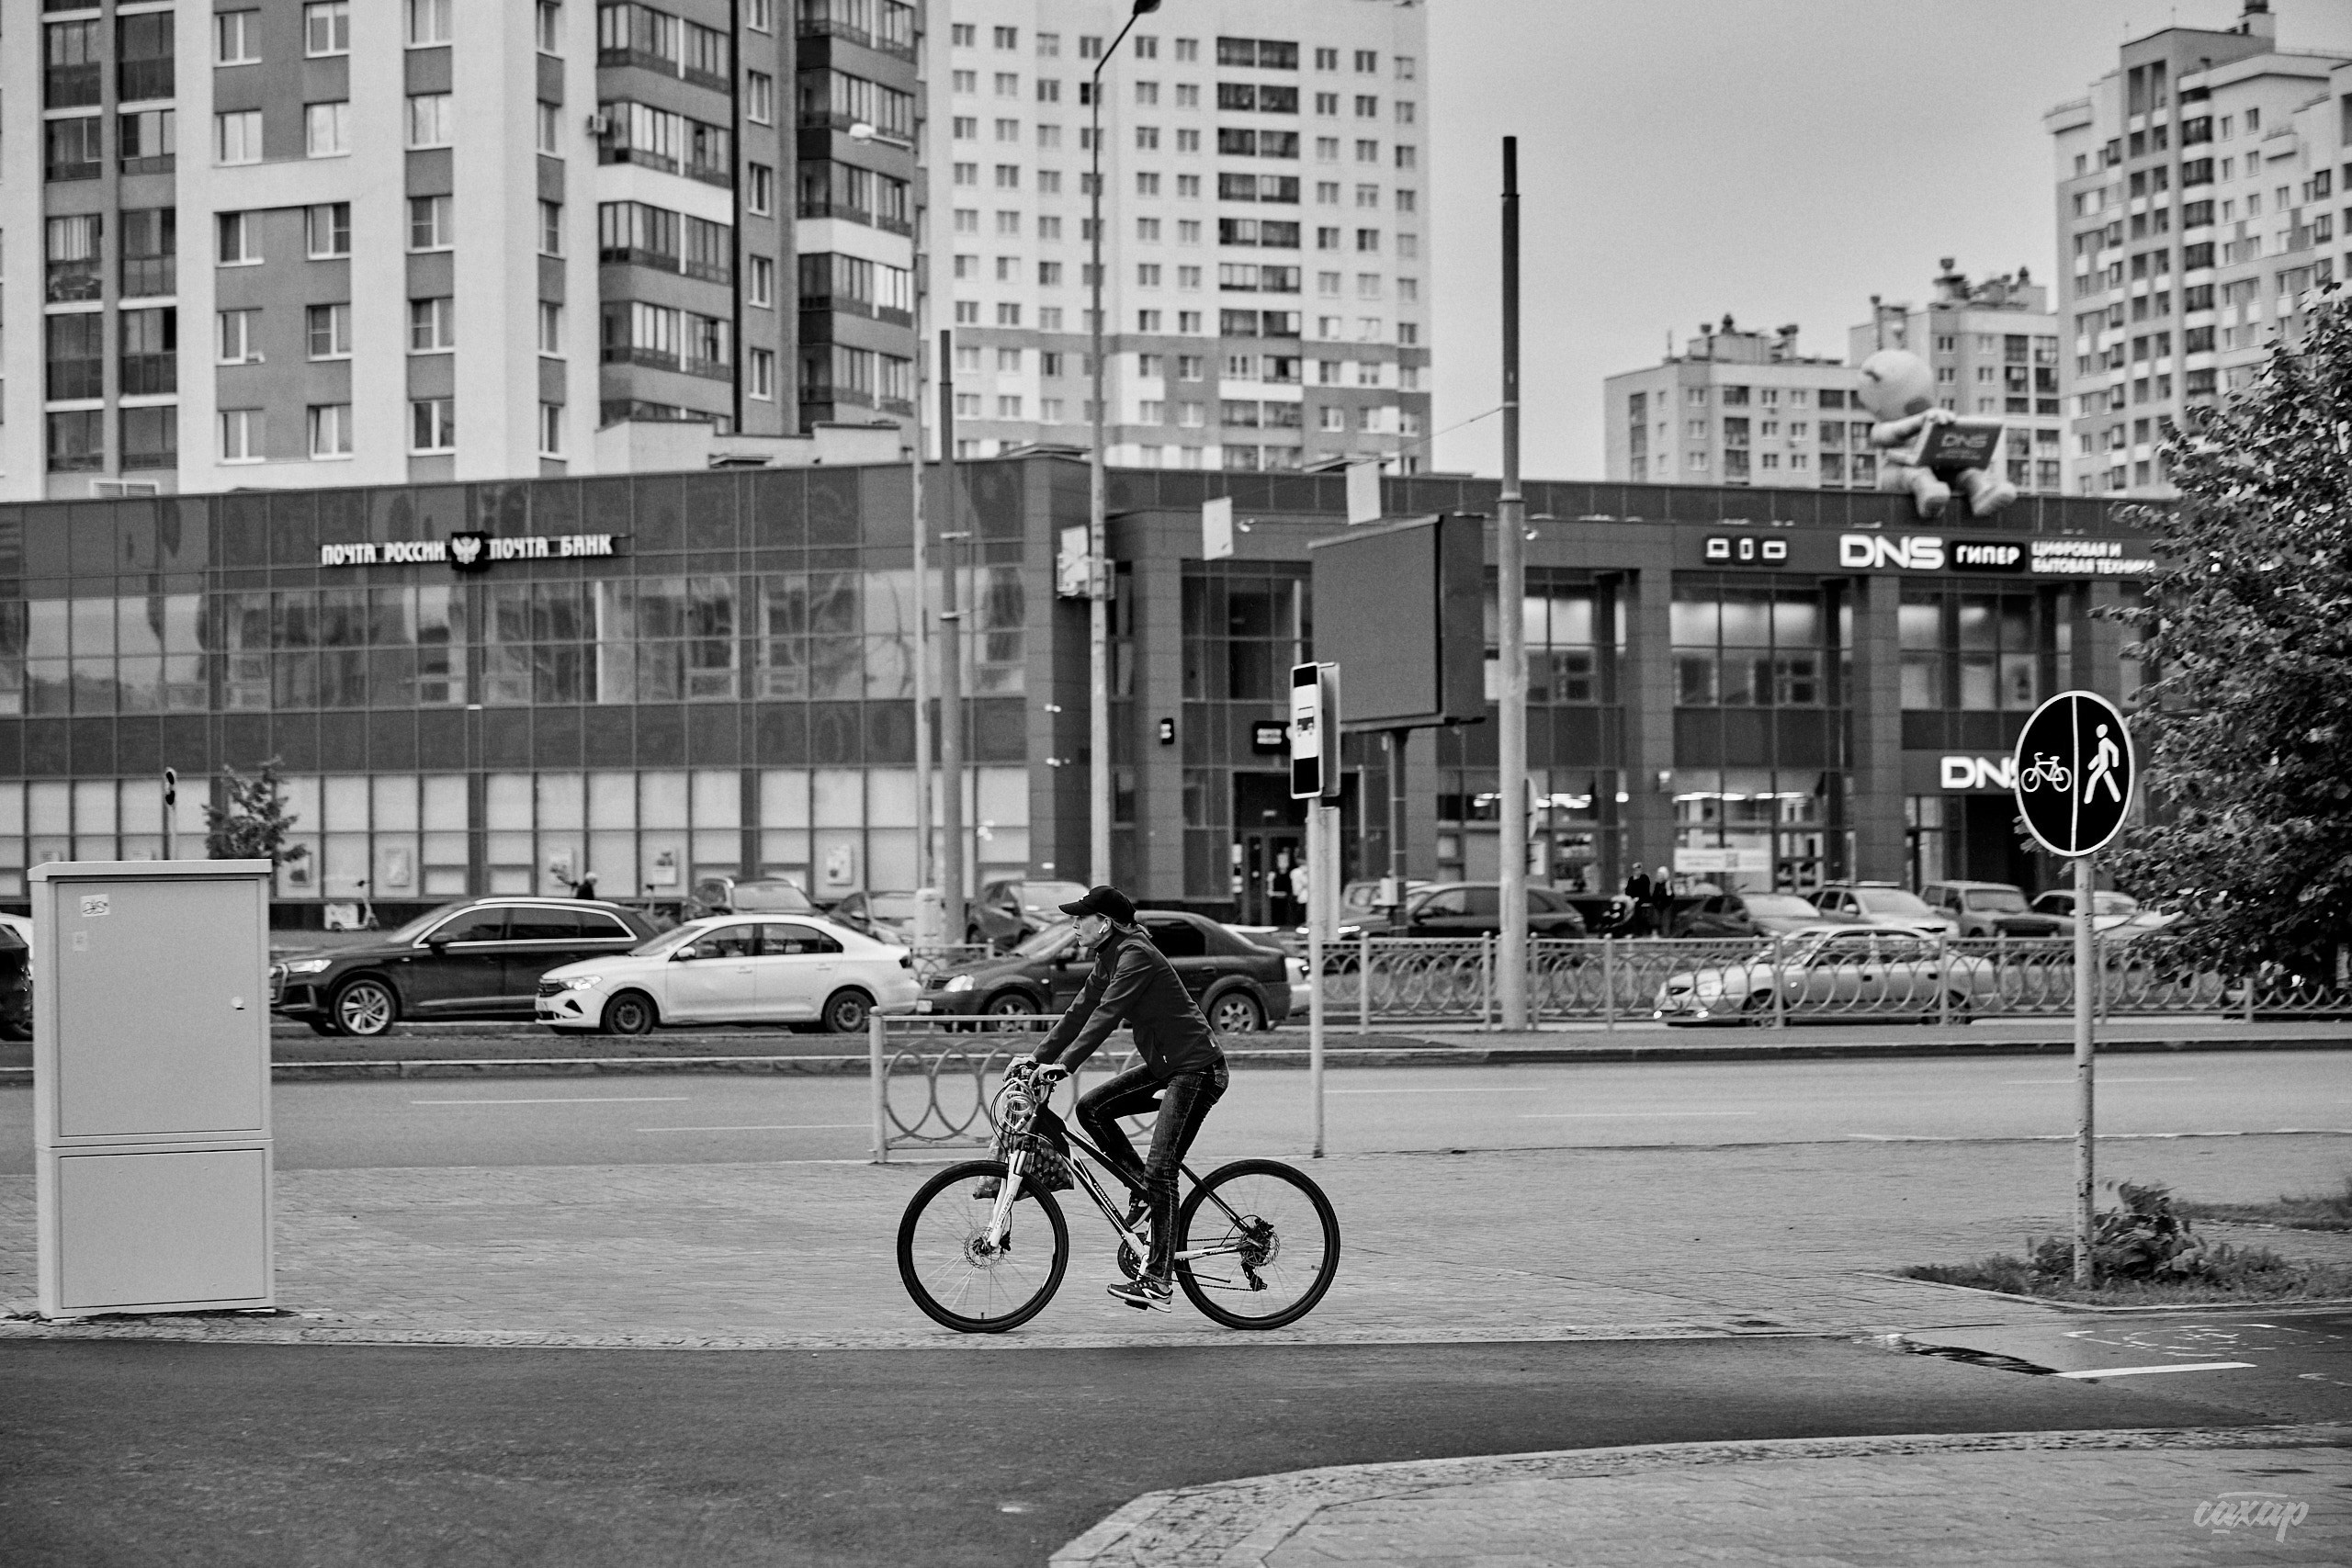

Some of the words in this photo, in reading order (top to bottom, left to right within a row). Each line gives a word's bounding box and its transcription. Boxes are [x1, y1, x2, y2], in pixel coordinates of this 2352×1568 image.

[322, 543, 377, 565] ПОЧТА
[384, 540, 447, 562] РОССИИ
[490, 536, 548, 559] ПОЧТА
[560, 534, 613, 556] БАНК
[1839, 534, 1945, 570] DNS
[1956, 545, 2020, 565] ГИПЕР
[2031, 540, 2108, 558] ЦИФРОВАЯ
[2109, 542, 2122, 558] И
[2031, 557, 2095, 573] БЫТОВАЯ
[1940, 756, 2018, 789] DN
